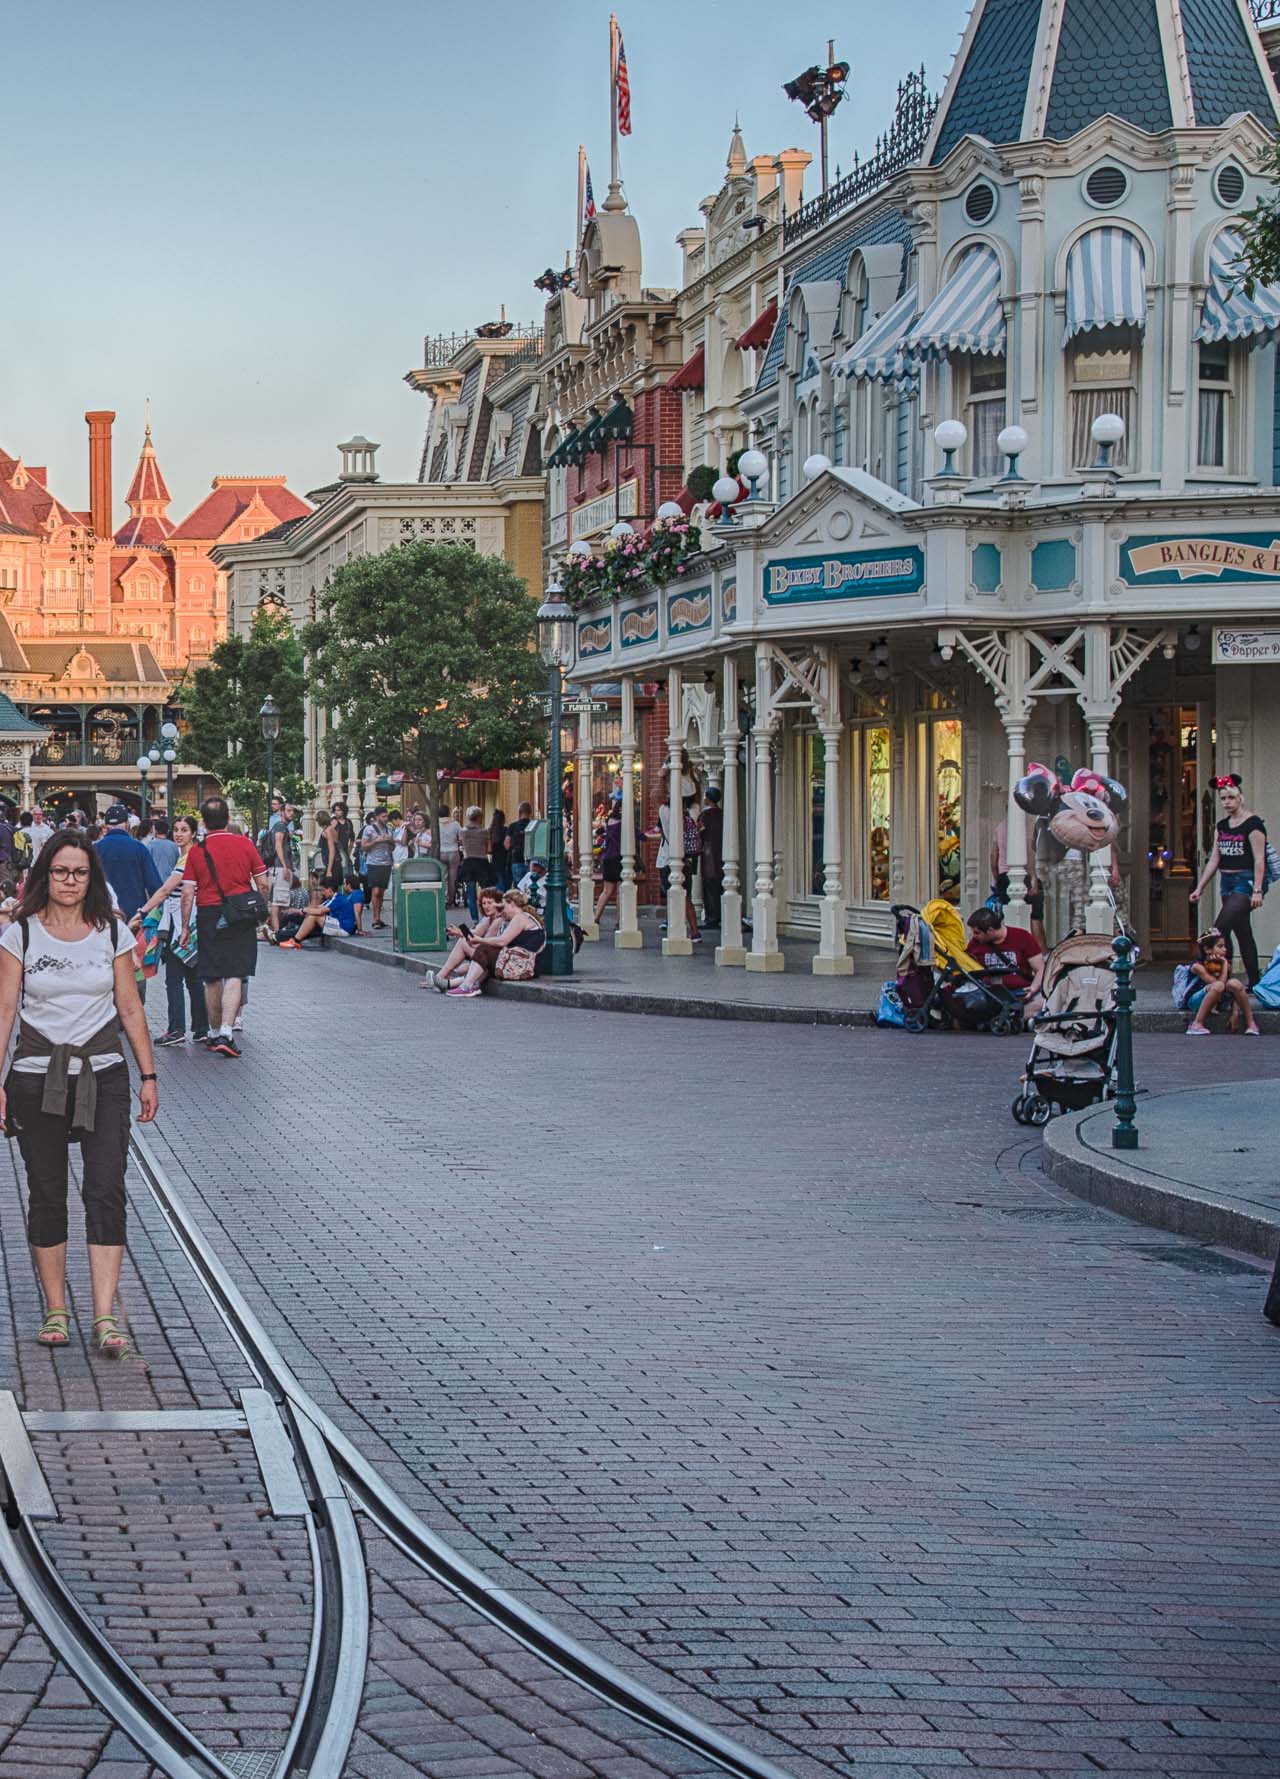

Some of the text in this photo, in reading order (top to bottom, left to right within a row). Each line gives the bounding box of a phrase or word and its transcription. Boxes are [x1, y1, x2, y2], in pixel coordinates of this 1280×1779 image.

[1160, 543, 1246, 565] BANGLES
[1252, 552, 1267, 570] &
[768, 559, 914, 594] BIXBY BROTHERS
[1230, 642, 1270, 658] Dapper
